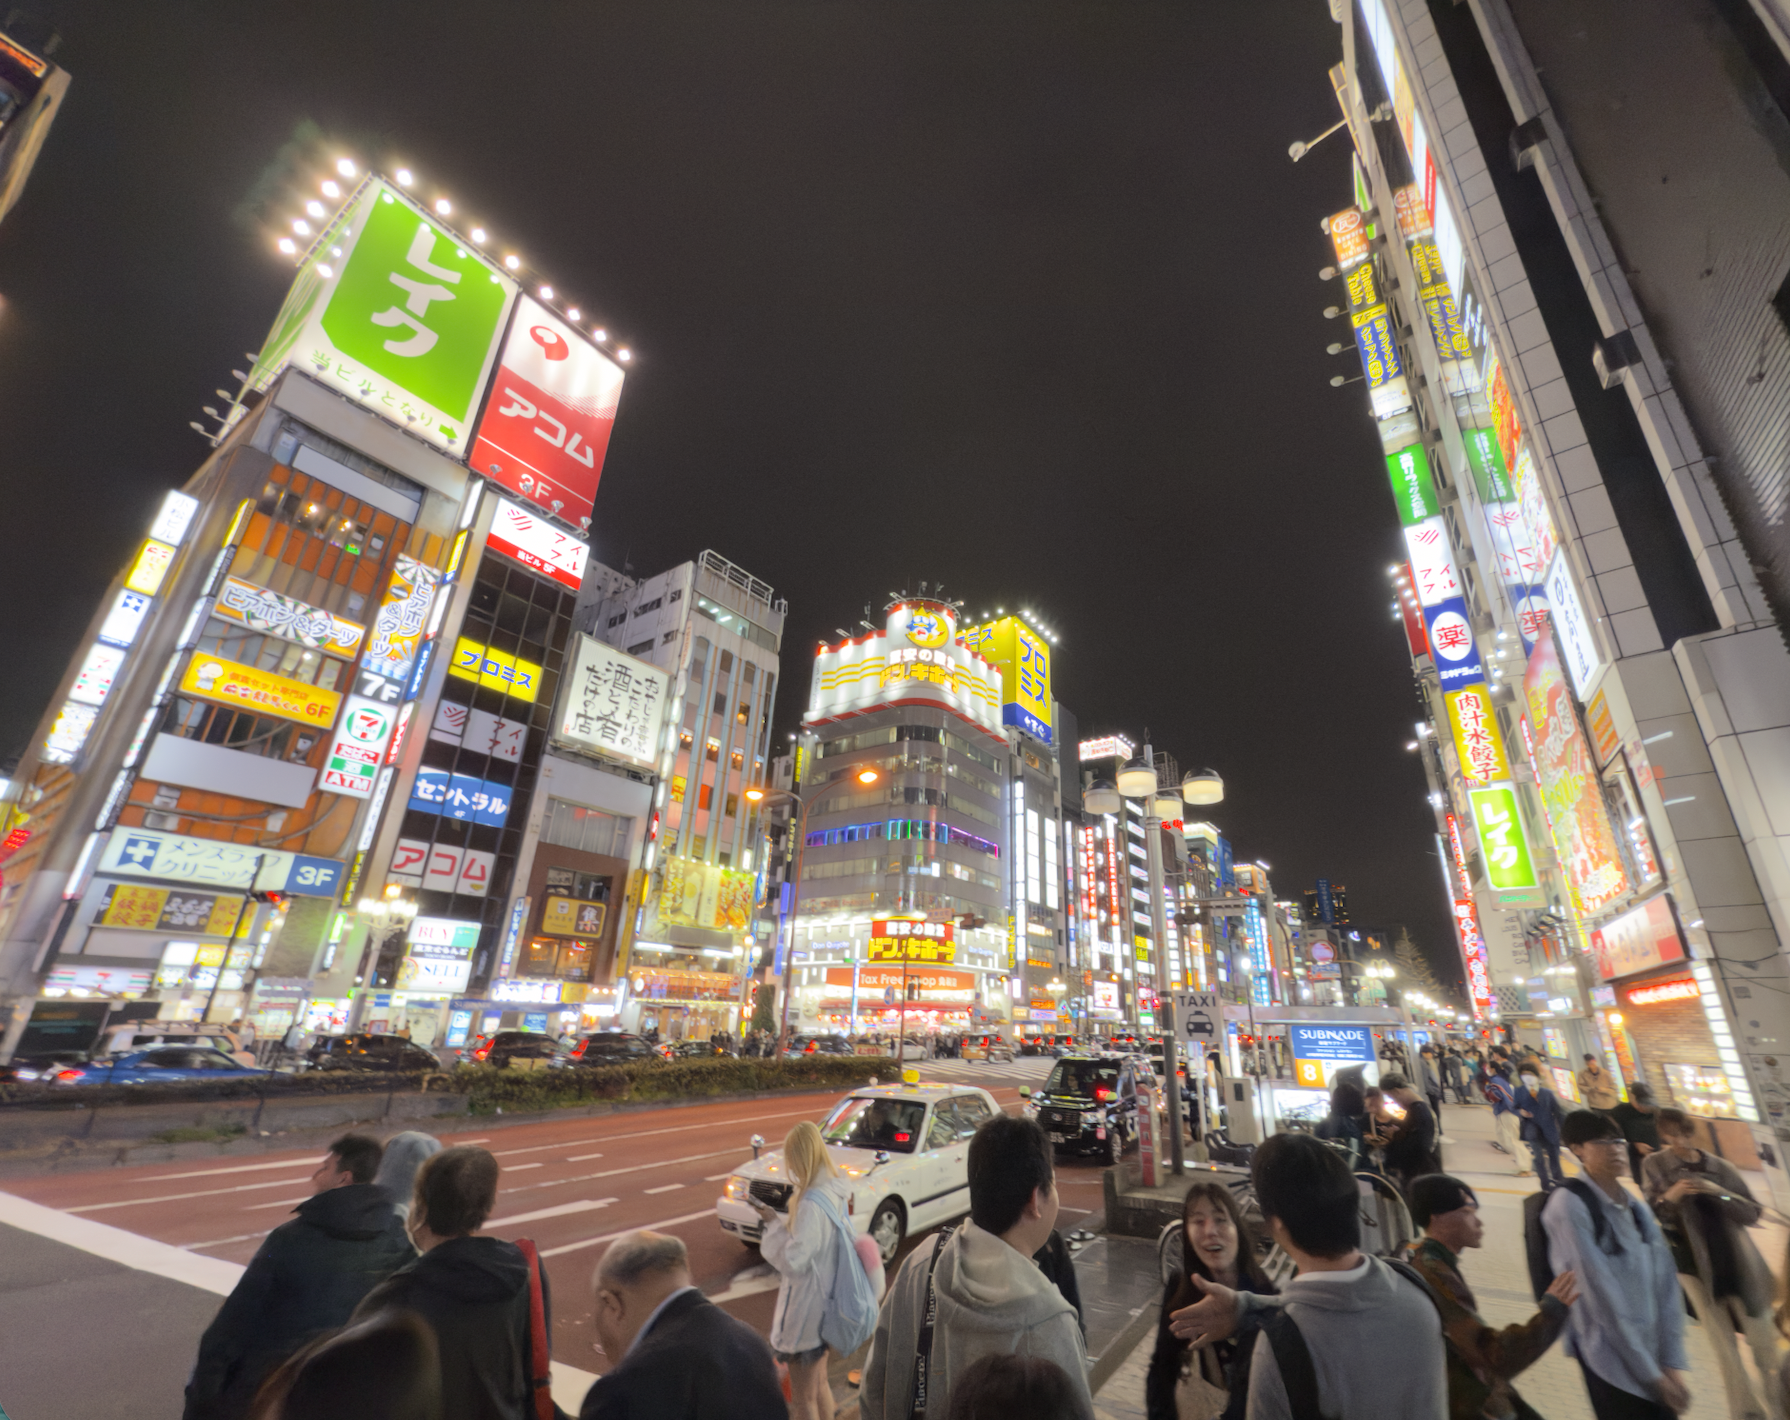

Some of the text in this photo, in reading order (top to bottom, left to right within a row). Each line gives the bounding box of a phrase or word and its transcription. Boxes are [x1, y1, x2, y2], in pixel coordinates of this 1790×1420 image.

[371, 228, 461, 358] レイク
[1346, 271, 1363, 305] Table
[1359, 262, 1376, 304] Cheese
[310, 350, 433, 425] 当ビルとなり
[499, 387, 595, 470] アコム
[519, 473, 552, 498] 3F
[550, 532, 582, 571] アイフル
[1436, 624, 1469, 650] 薬
[462, 650, 532, 689] プロミス
[1019, 636, 1047, 708] プロミス
[361, 672, 401, 702] 7F
[305, 702, 331, 718] 6F
[1458, 693, 1499, 781] 肉汁水餃子
[338, 743, 378, 763] たばこ
[343, 760, 362, 776] 酒
[327, 773, 370, 791] ATM
[416, 778, 507, 815] セントラル
[1481, 803, 1518, 869] レイク
[166, 841, 281, 868] メンズライフ
[393, 846, 487, 882] アコム
[159, 860, 255, 885] クリニック
[296, 865, 334, 887] 3F
[418, 925, 449, 940] BUY
[424, 963, 463, 977] SELL
[860, 973, 878, 985] Tax
[880, 972, 903, 985] Free
[1179, 995, 1216, 1007] TAXI
[1299, 1029, 1365, 1041] SUBNADE
[1303, 1064, 1317, 1081] 8
